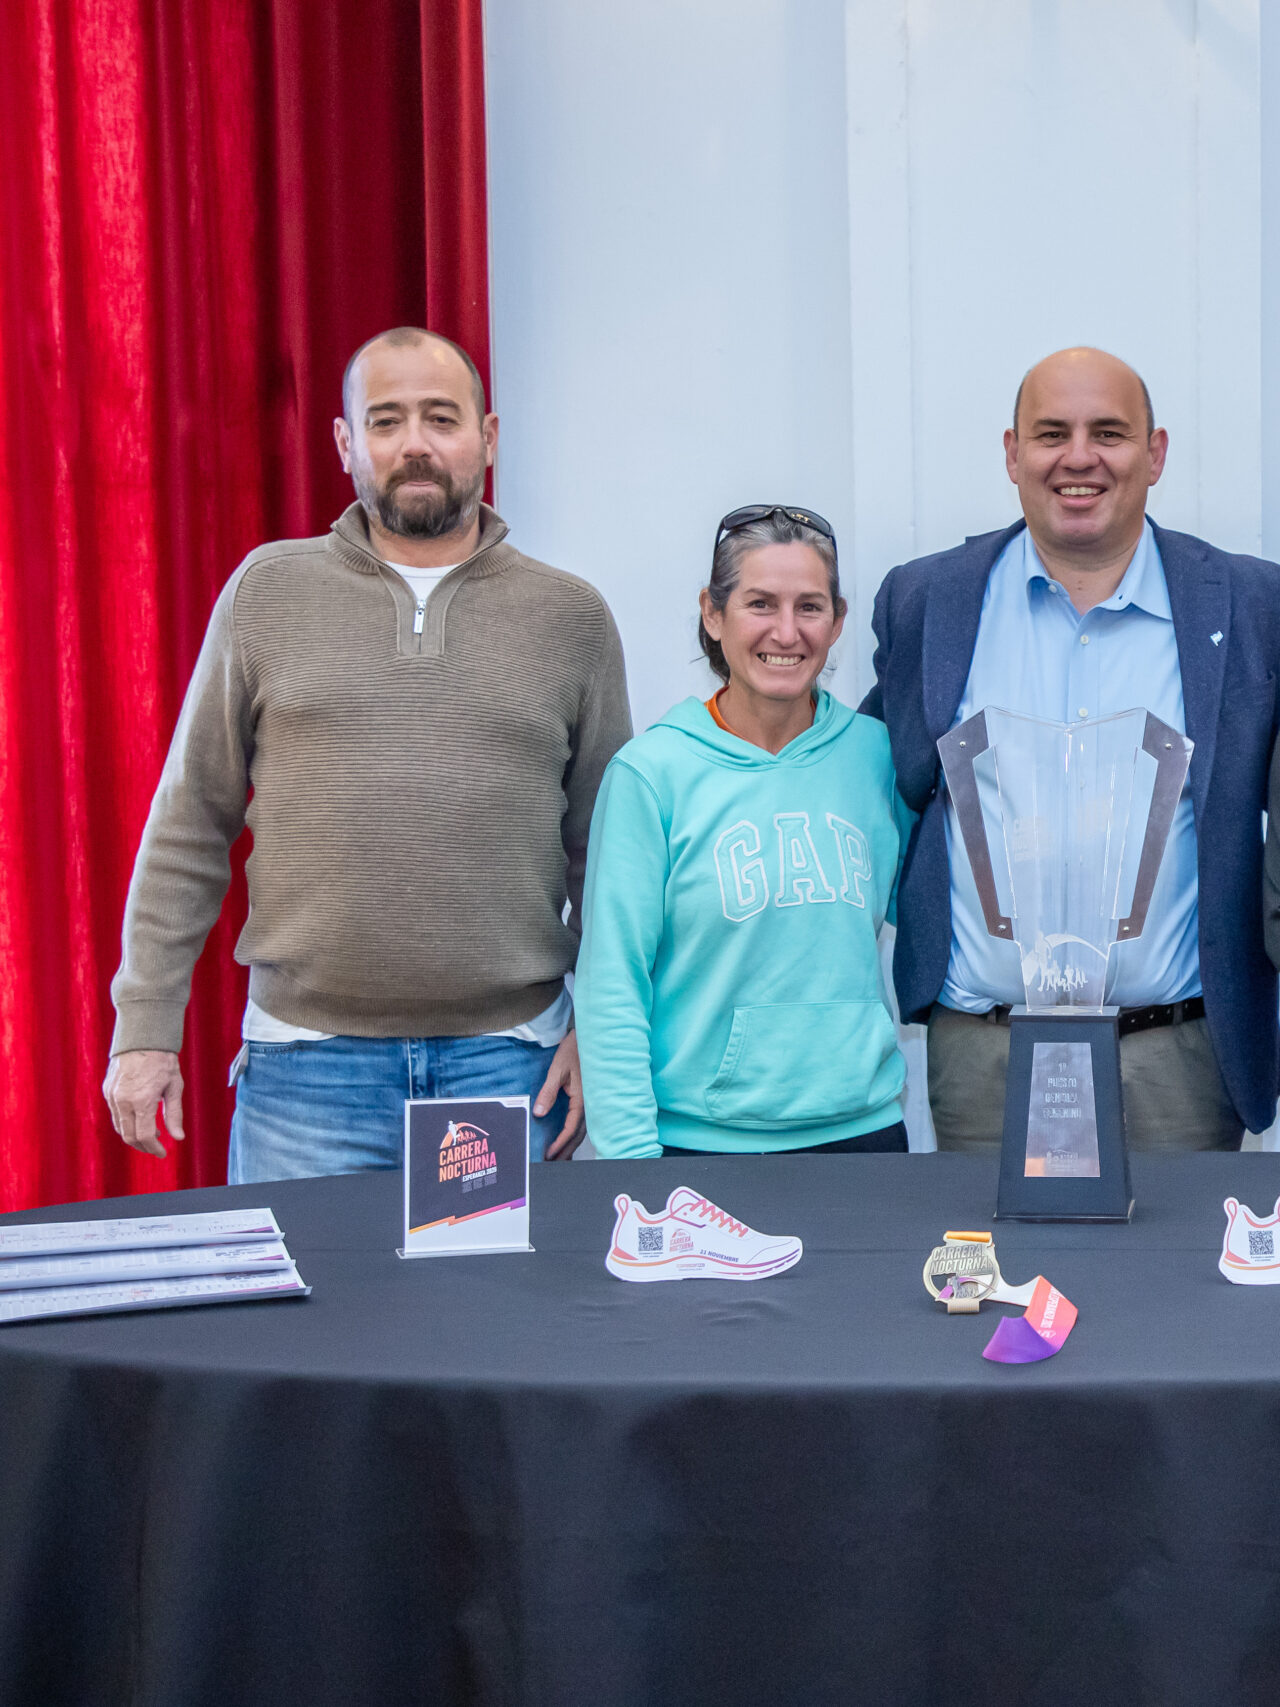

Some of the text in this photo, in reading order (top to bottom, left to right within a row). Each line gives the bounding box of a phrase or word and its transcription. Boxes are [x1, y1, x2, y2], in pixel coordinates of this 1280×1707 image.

[713, 812, 872, 923] GAP
[439, 1138, 489, 1166] CARRERA
[439, 1151, 497, 1183] NOCTURNA
[708, 1250, 740, 1263] NOVIEMBRE
[933, 1245, 982, 1261] CARRERA
[930, 1256, 988, 1274] NOCTURNA
